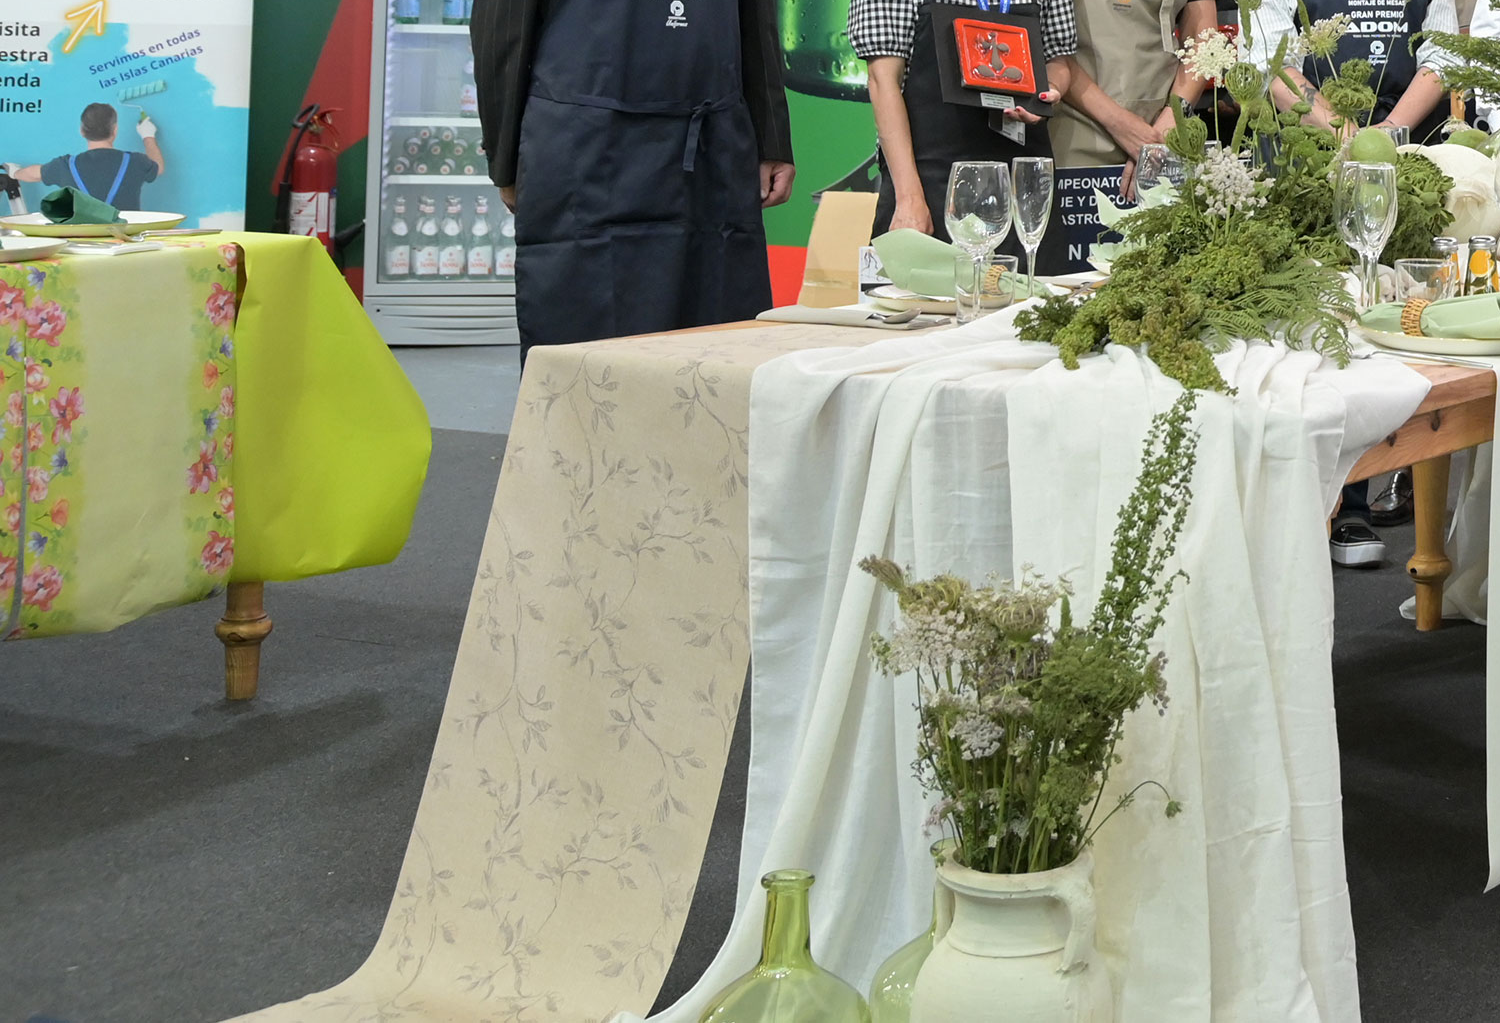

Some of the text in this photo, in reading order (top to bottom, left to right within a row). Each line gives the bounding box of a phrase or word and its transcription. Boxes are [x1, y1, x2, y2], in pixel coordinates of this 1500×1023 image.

[0, 22, 40, 37] isita
[1345, 21, 1408, 33] ADOM
[0, 50, 48, 62] estra
[89, 28, 201, 75] Servimos en todas
[98, 46, 204, 89] las Islas Canarias
[0, 99, 42, 114] line!
[1077, 196, 1086, 207] Y
[1062, 214, 1101, 225] STRO
